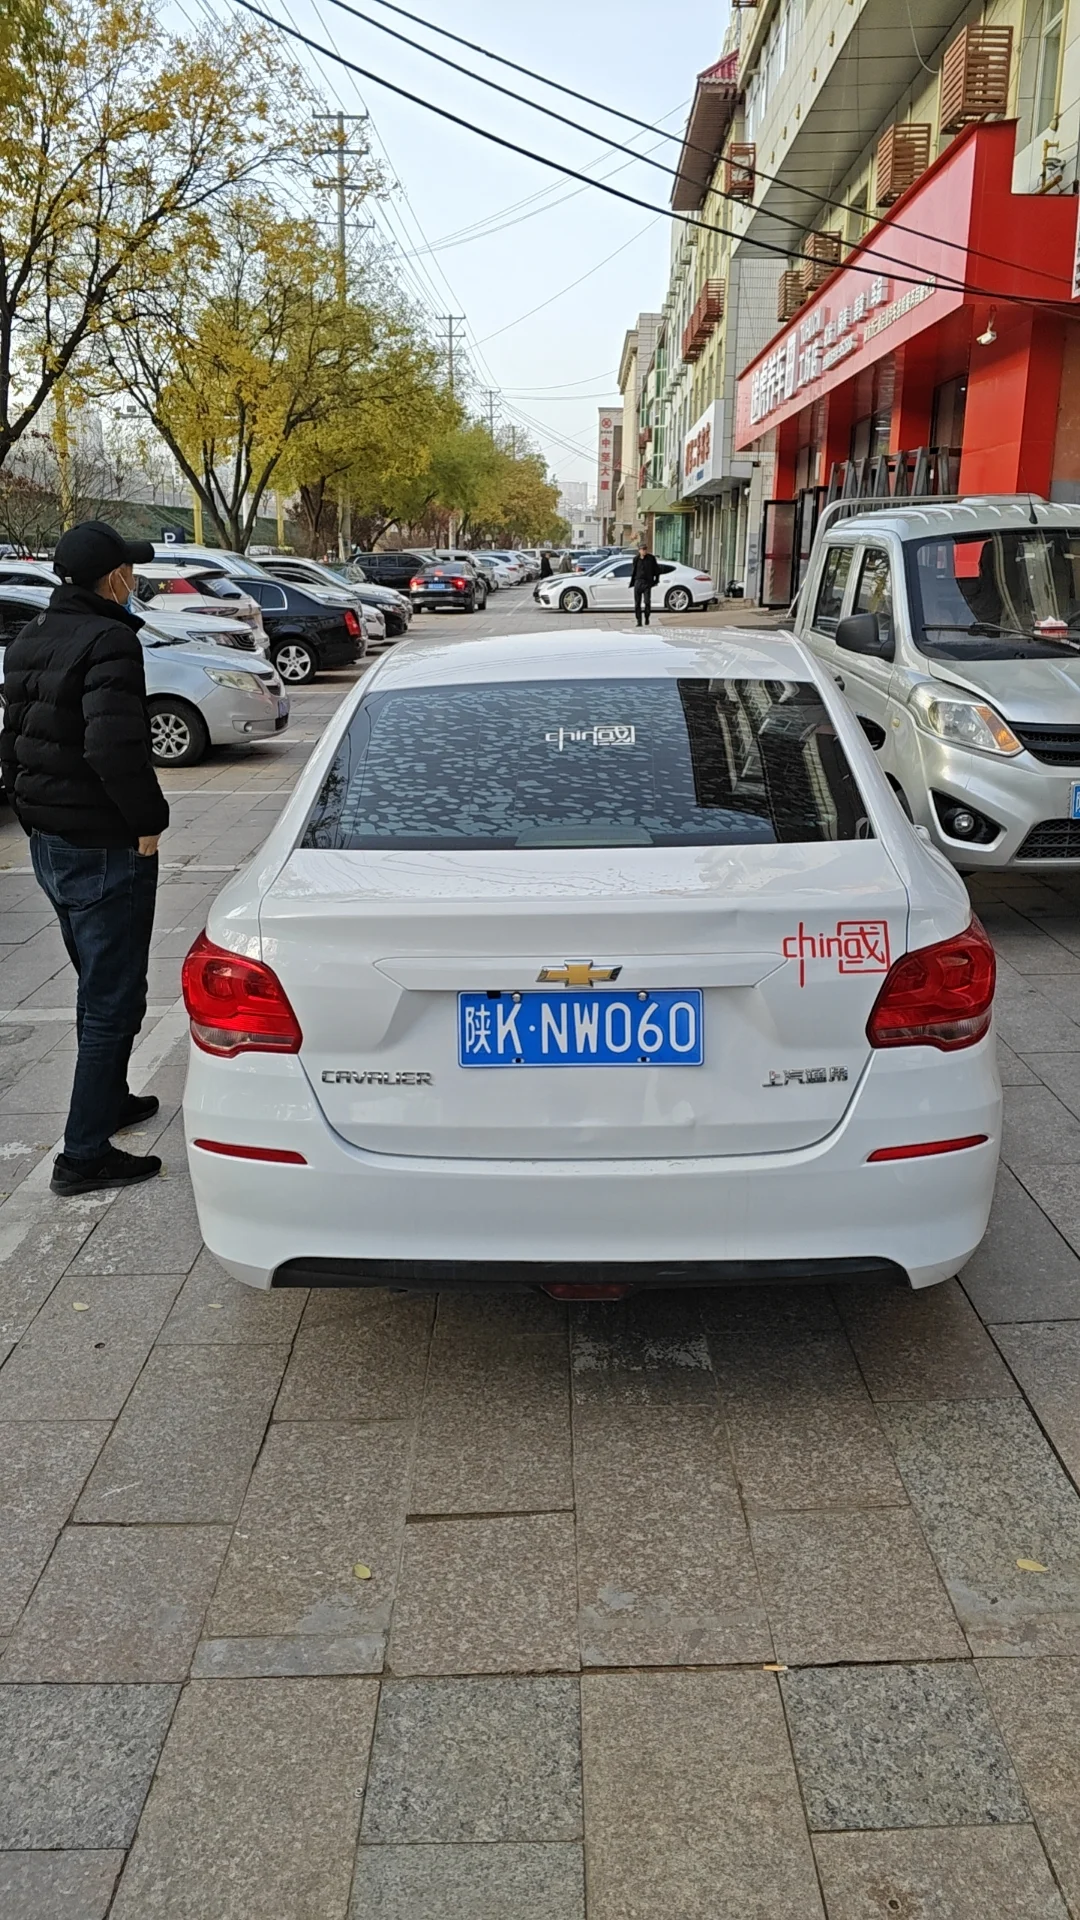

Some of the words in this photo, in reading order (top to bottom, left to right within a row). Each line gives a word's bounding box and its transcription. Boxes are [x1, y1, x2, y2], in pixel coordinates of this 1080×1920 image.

[164, 532, 176, 545] P
[465, 1002, 696, 1054] 陕K·NW060
[321, 1070, 434, 1086] CAVALIER
[762, 1066, 849, 1087] 上汽通用
